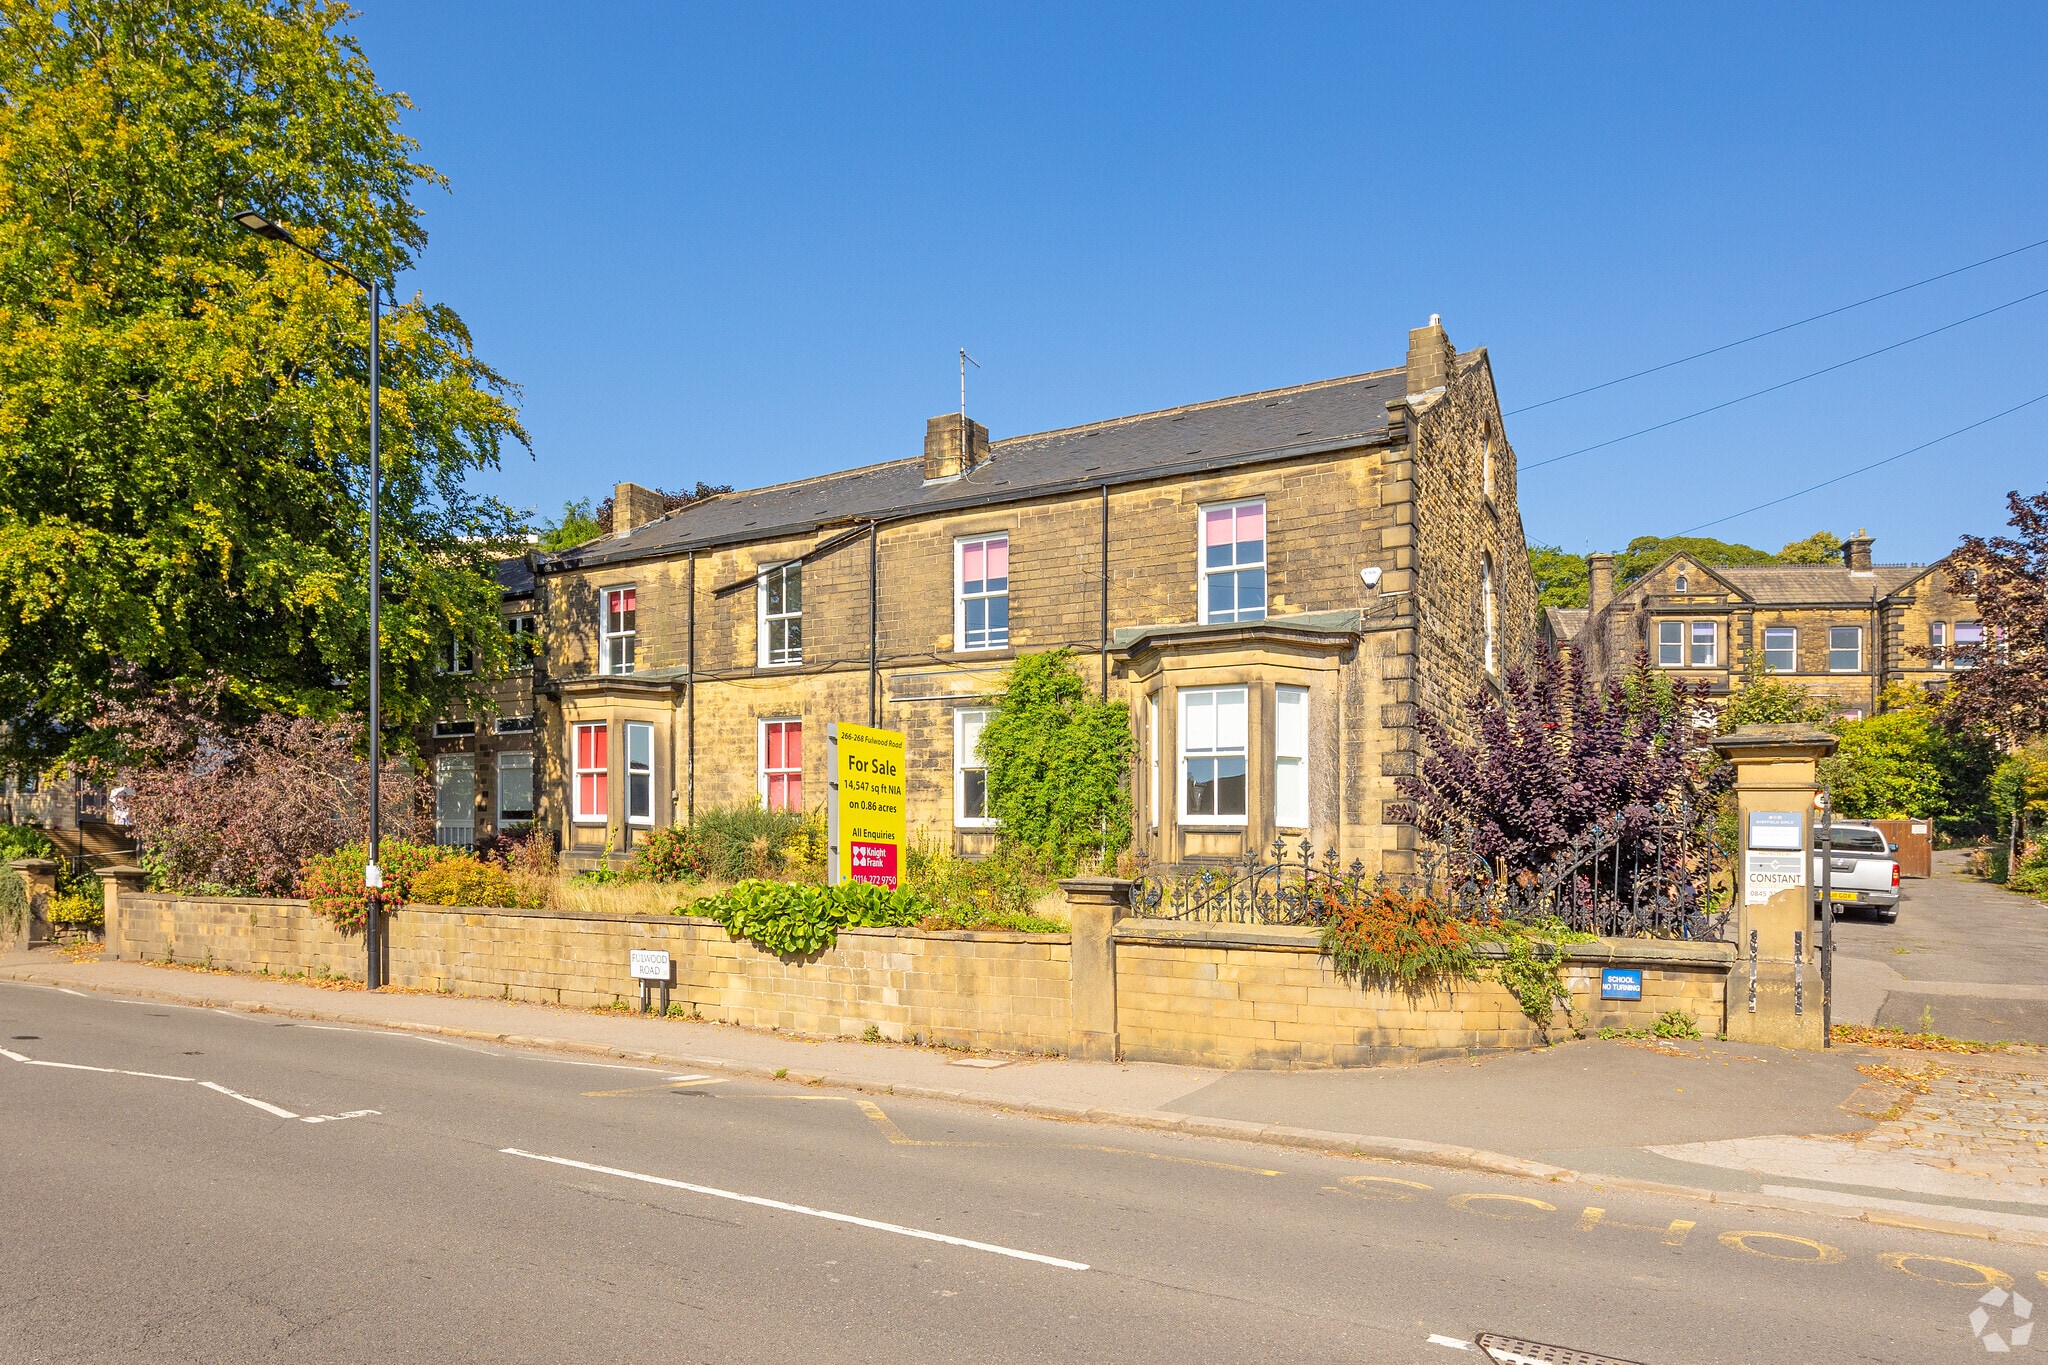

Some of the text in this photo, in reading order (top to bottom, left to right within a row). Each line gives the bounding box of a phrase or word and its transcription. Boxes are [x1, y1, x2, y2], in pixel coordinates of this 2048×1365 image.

[841, 732, 902, 748] 266-268 Fulwood Road
[849, 755, 896, 776] For Sale
[845, 780, 901, 795] 14,547 sq ft NIA
[849, 800, 897, 813] on 0.86 acres
[852, 828, 895, 840] All Enquiries
[867, 847, 886, 859] Knight
[867, 857, 883, 867] Frank
[869, 875, 880, 885] 272
[881, 875, 897, 885] 9750
[1750, 873, 1801, 883] CONSTANT
[632, 953, 667, 964] FULWOOD
[640, 966, 660, 975] ROAD
[1607, 975, 1634, 983] SCHOOL
[1613, 984, 1640, 992] TURNING
